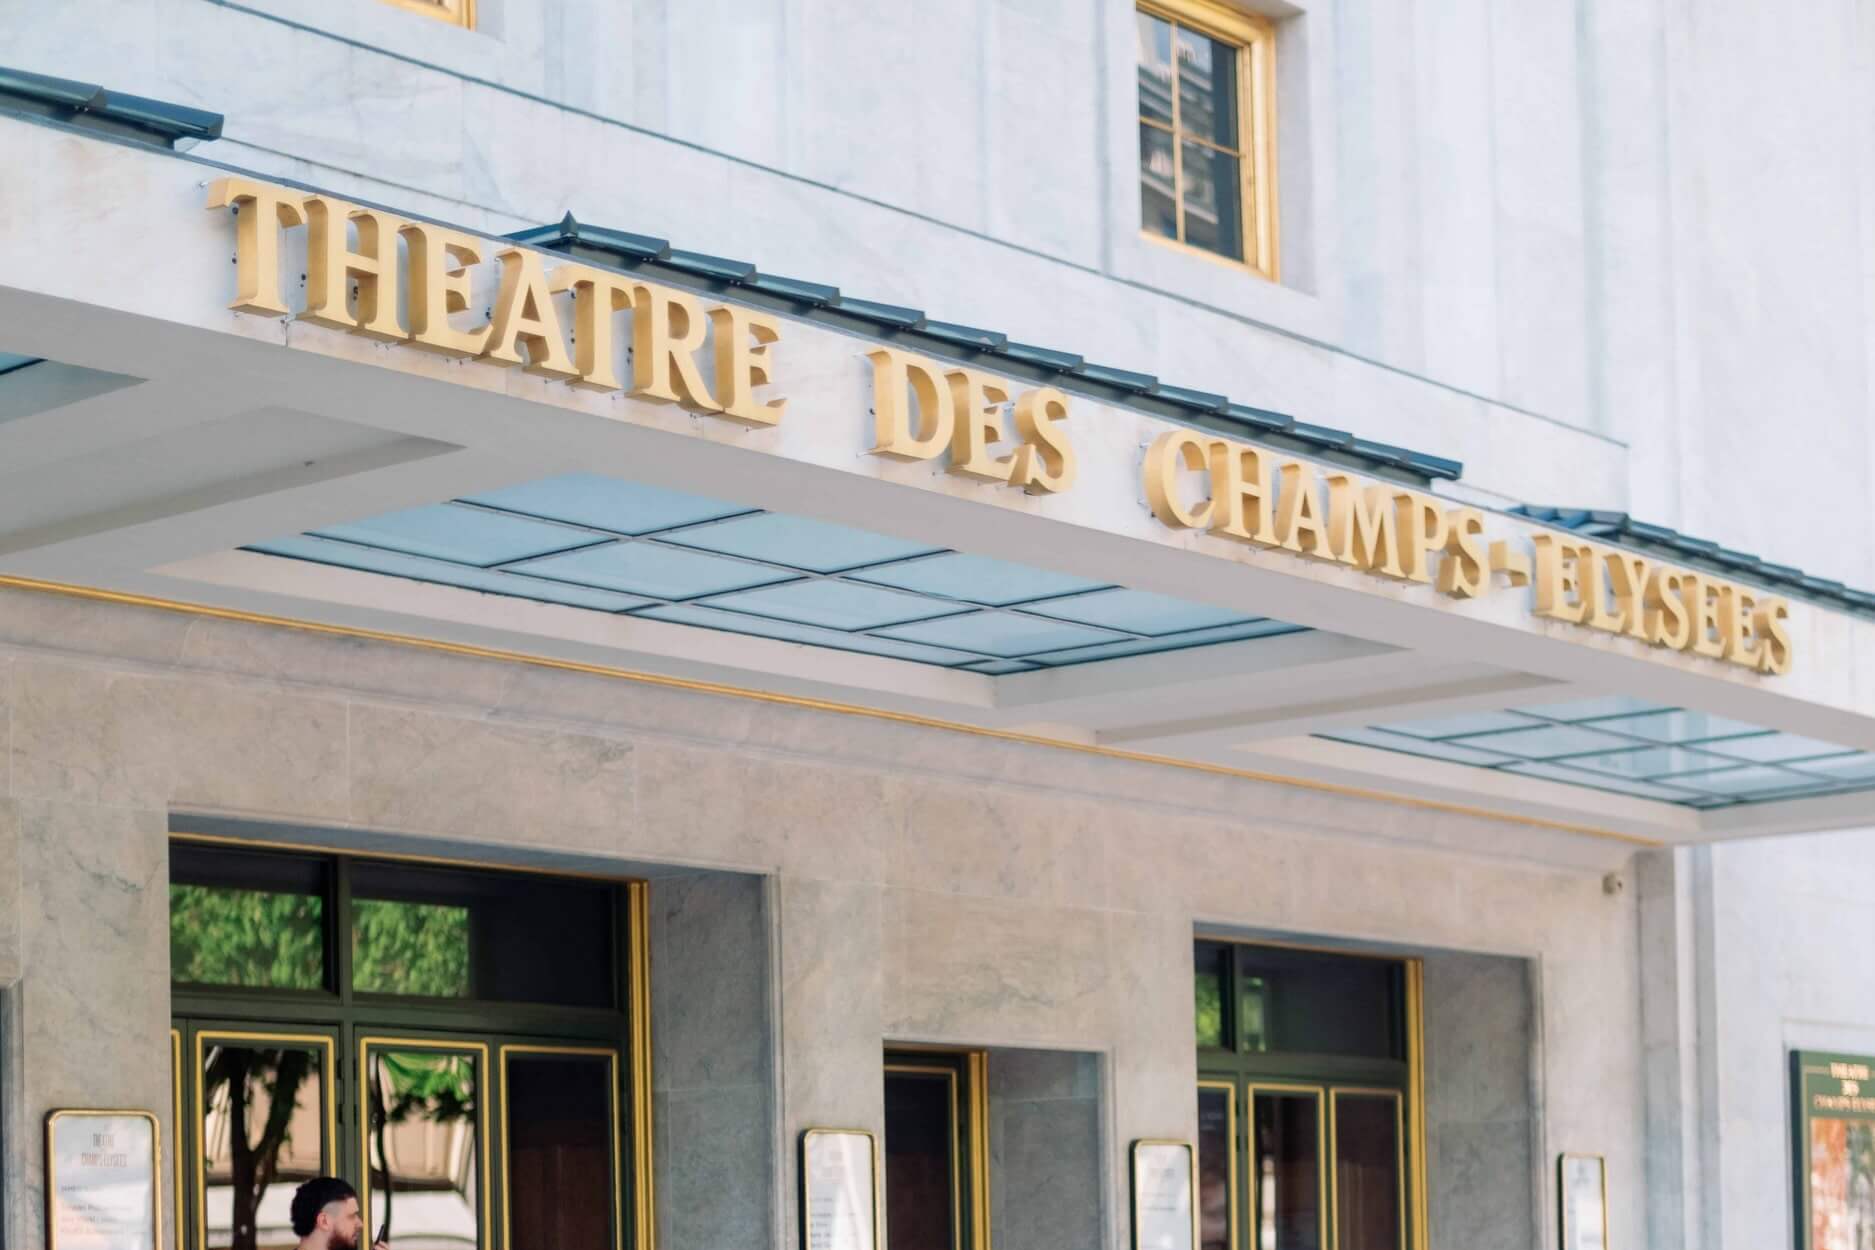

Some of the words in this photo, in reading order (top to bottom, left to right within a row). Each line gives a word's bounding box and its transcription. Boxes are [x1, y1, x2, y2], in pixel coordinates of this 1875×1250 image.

[206, 175, 788, 427] THEATRE
[866, 345, 1076, 494] DES
[1143, 428, 1793, 675] CHAMPS-ELYSEES
